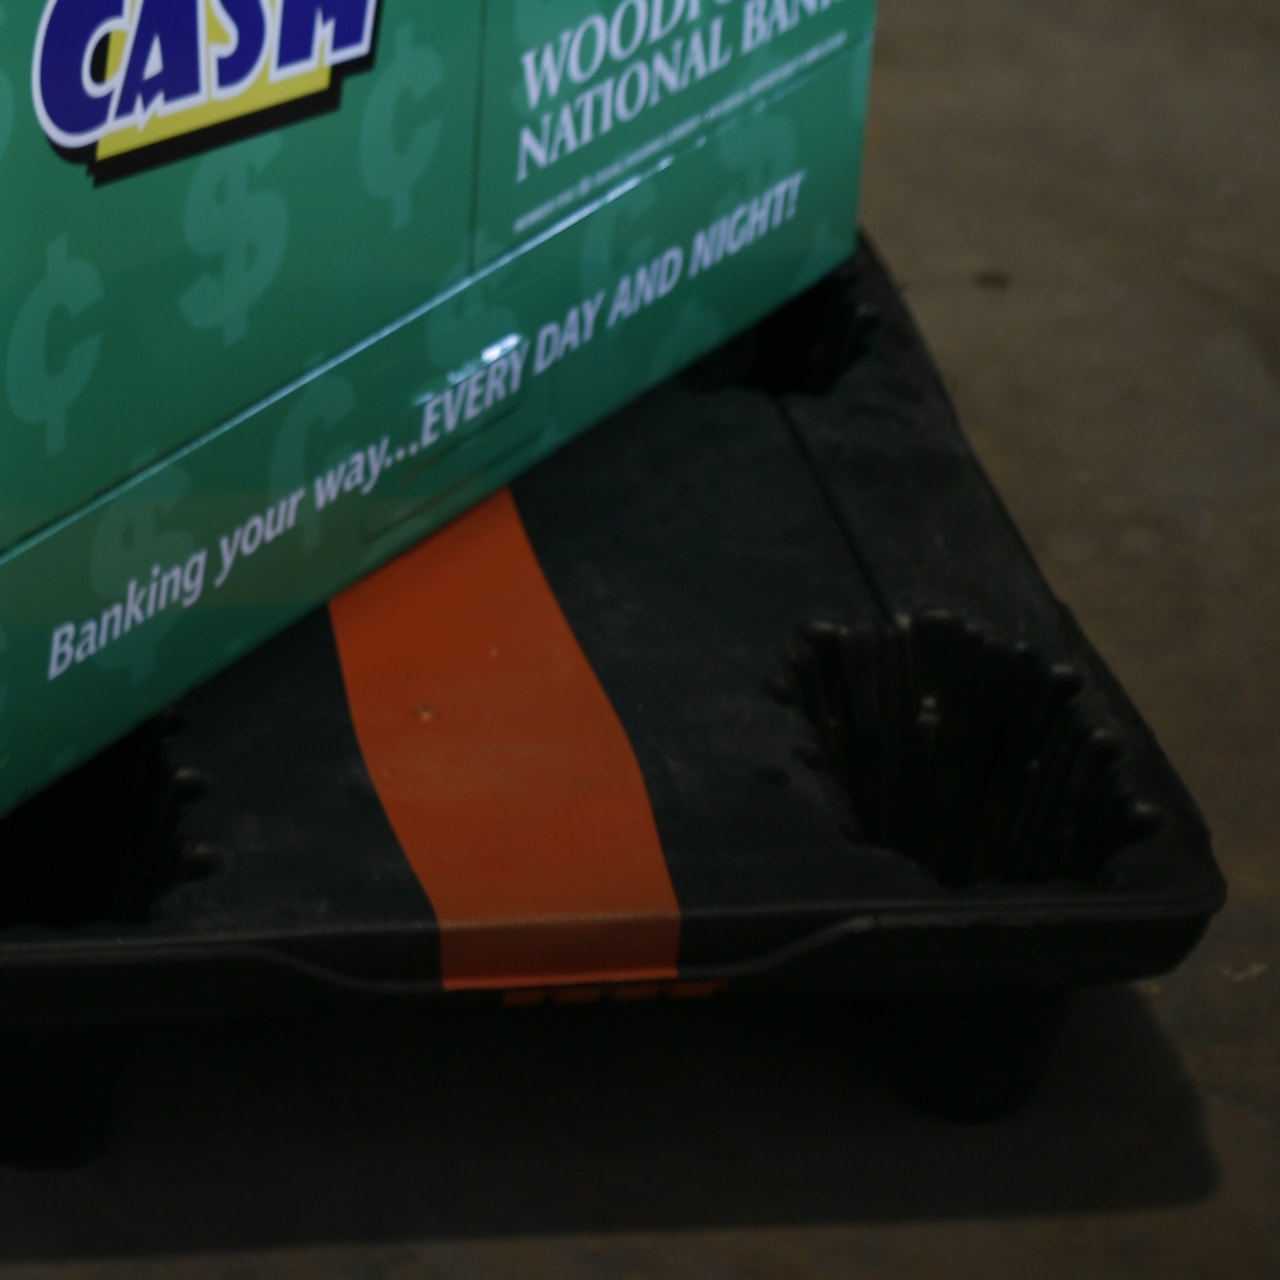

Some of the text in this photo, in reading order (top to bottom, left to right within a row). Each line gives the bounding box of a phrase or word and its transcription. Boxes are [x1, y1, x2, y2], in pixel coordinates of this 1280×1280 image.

[517, 17, 732, 184] NATIONAL
[47, 550, 207, 681] Banking
[215, 490, 303, 587] your
[534, 292, 605, 374] DAY
[607, 248, 684, 329] AND
[688, 171, 806, 281] NIGHT!
